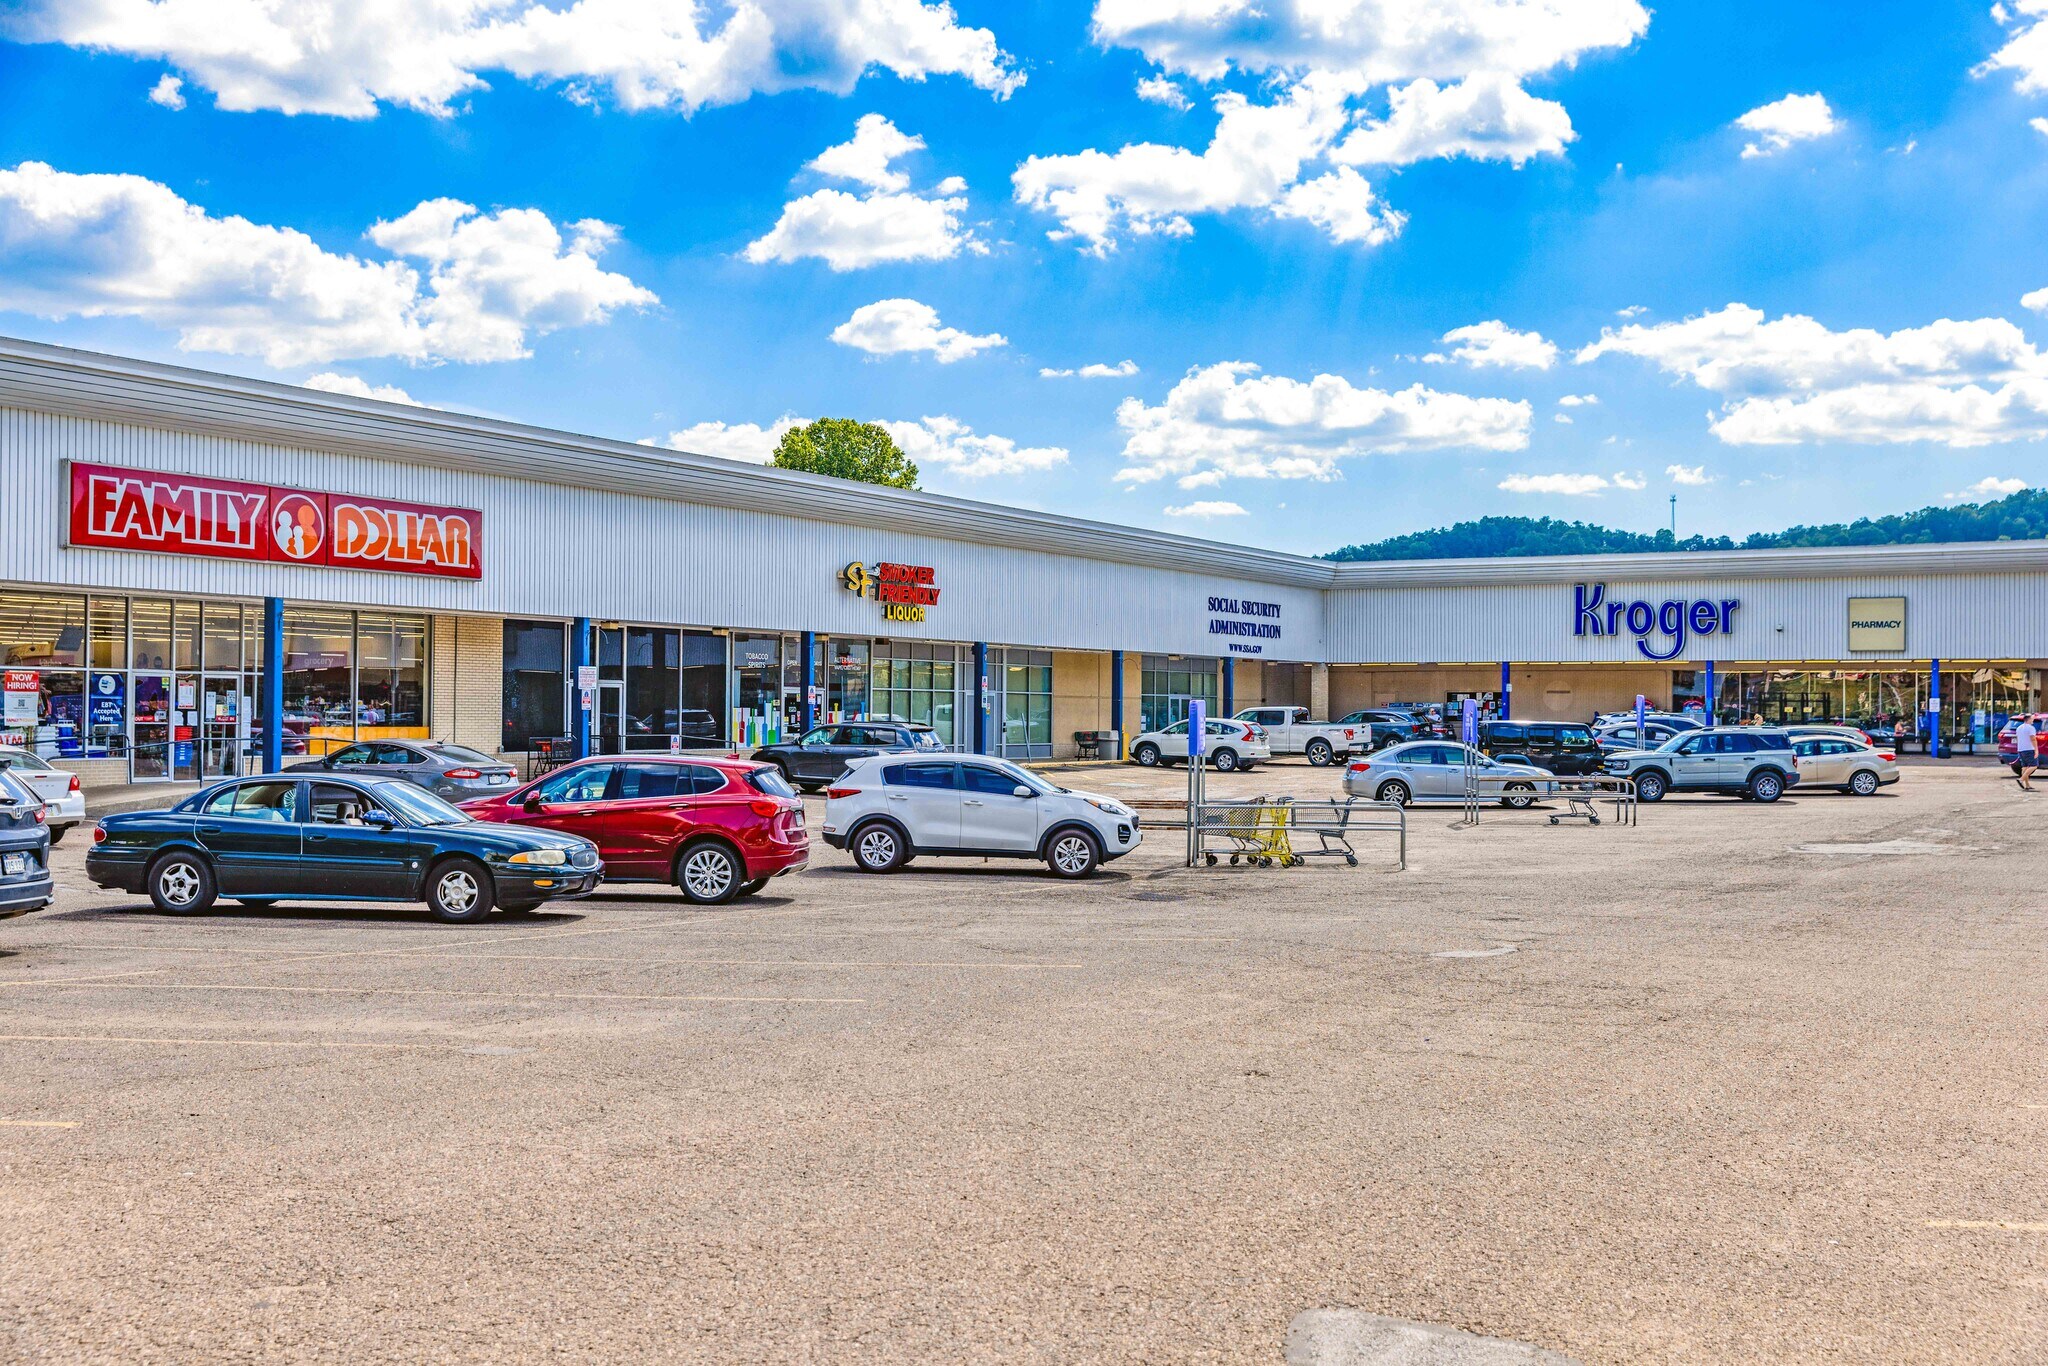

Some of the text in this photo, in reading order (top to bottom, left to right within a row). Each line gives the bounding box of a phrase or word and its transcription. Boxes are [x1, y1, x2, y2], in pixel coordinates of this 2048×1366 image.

[88, 474, 472, 569] FAMILY DOLLAR
[880, 562, 934, 585] SMOKER
[879, 583, 941, 606] FRIENDLY
[886, 605, 925, 622] LIQUOR
[1208, 597, 1281, 618] SOCIAL SECURITY
[1573, 583, 1739, 661] Kroger
[1851, 620, 1902, 629] PHARMACY
[1208, 619, 1281, 638] ADMINISTRATION
[1228, 643, 1262, 654] WWW.SSA.GOV
[745, 652, 769, 660] TOBACCO
[304, 657, 334, 669] grocery
[748, 661, 766, 669] SPIRITS
[11, 673, 33, 681] NOW
[7, 682, 37, 690] HIRING!
[93, 708, 121, 716] Accepted
